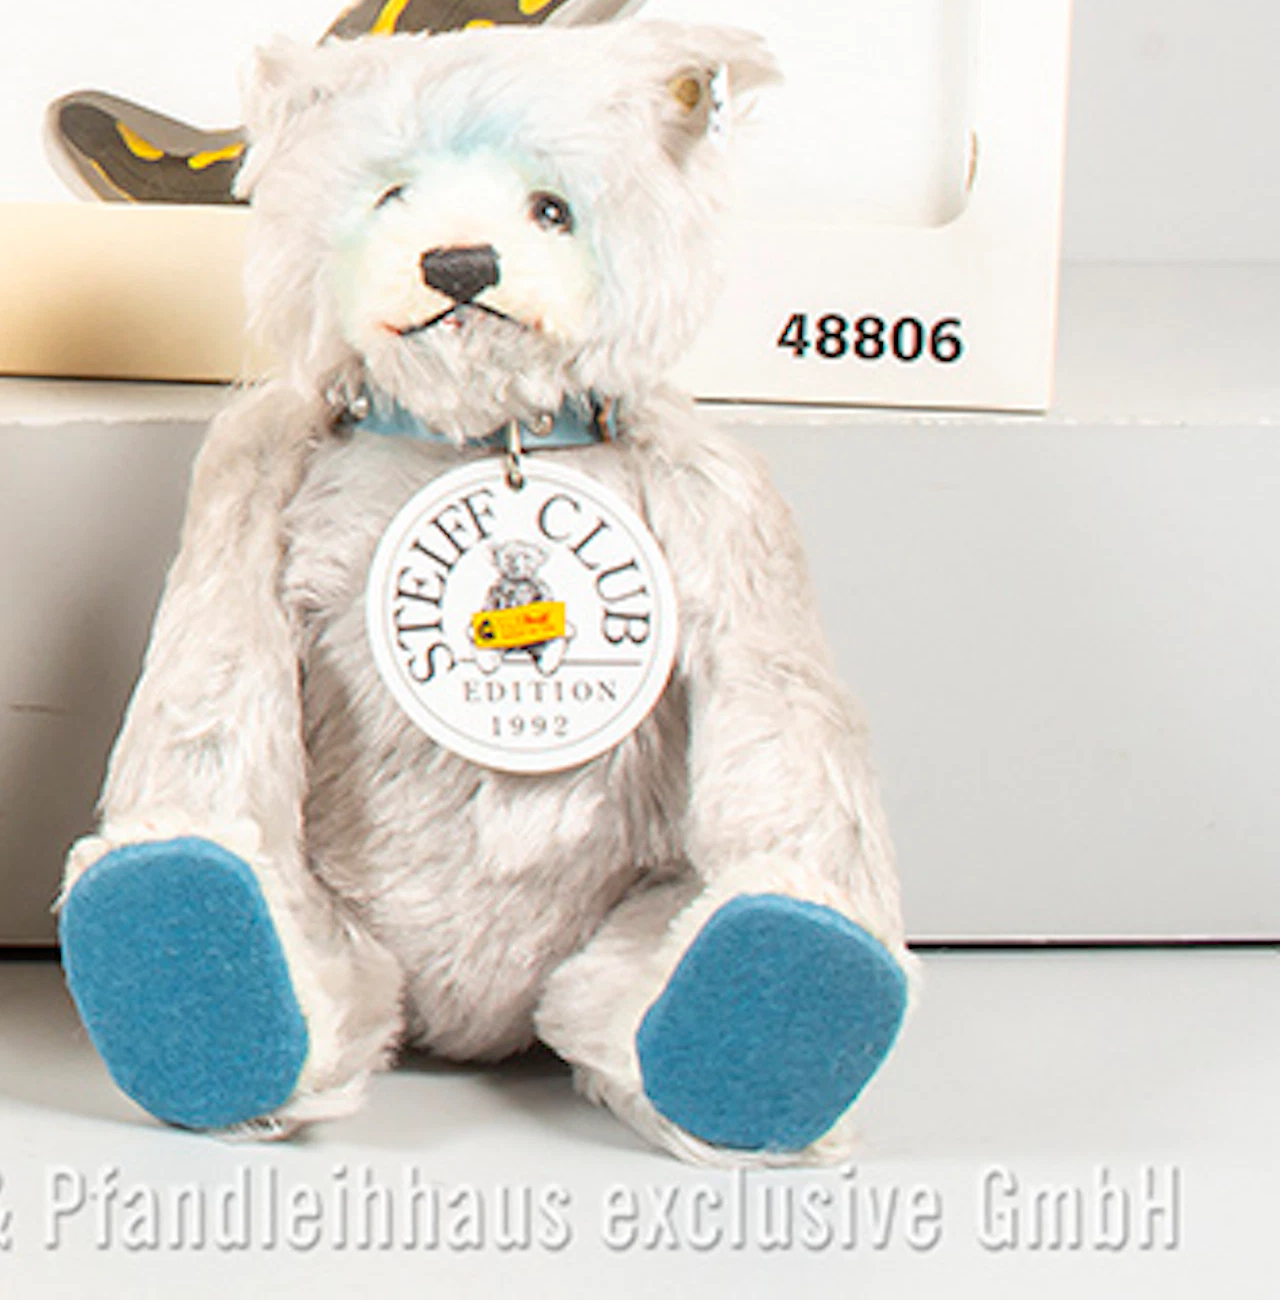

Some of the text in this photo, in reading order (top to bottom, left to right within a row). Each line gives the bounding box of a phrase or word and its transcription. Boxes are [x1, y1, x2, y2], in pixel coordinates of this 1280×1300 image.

[777, 313, 964, 363] 48806
[393, 488, 651, 684] STEIFF CLUB
[463, 680, 617, 702] EDITION
[491, 714, 569, 738] 1992
